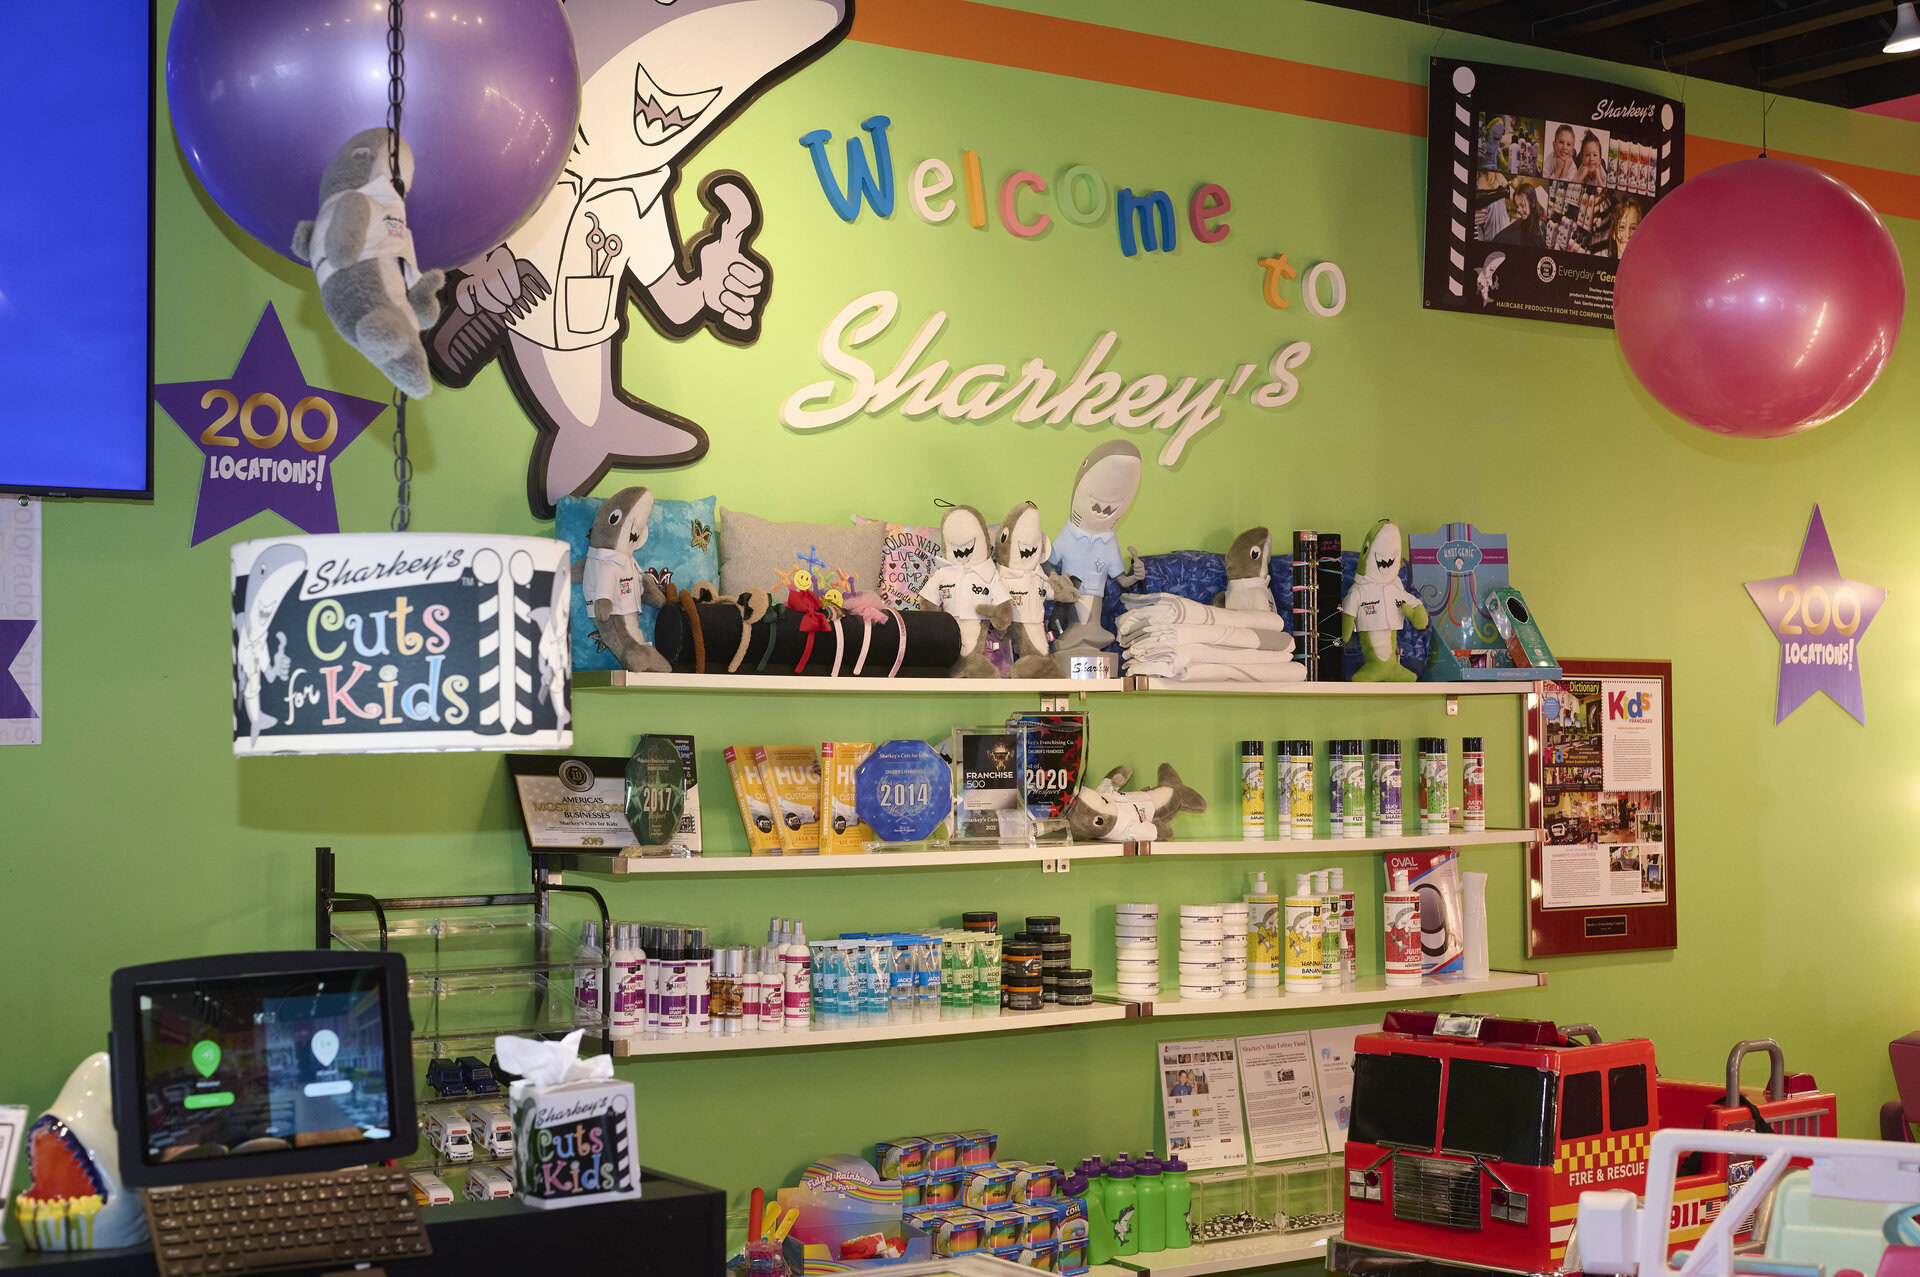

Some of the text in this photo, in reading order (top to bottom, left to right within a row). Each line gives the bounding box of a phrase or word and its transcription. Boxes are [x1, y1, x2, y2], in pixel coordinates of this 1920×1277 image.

[1592, 99, 1656, 123] Sharkey's
[799, 115, 1346, 317] Welcome to
[1558, 266, 1594, 282] Everyday
[1596, 270, 1616, 283] “Gen
[1496, 301, 1524, 310] HAIRCARE
[1524, 304, 1553, 313] PRODUCTS
[779, 290, 1311, 467] Sharkey's
[201, 389, 338, 452] 200
[210, 455, 326, 492] LOCATIONS!
[882, 532, 940, 557] COLOR WAR
[890, 552, 915, 561] LIVE
[14, 509, 40, 618] olorado
[308, 548, 464, 595] Sharkey's
[901, 562, 909, 571] 4
[1778, 584, 1861, 636] 200
[306, 596, 451, 661] Cuts
[1785, 638, 1854, 672] LOCATIONS!
[284, 655, 470, 726] for Kids
[1608, 690, 1650, 720] Kids
[1544, 747, 1568, 764] Kids
[774, 766, 821, 784] HUG
[966, 780, 986, 788] 500
[1026, 768, 1068, 790] 2020
[643, 788, 672, 812] 2017
[880, 784, 928, 806] 2014
[581, 837, 604, 845] 2019
[1392, 857, 1418, 867] OVAL
[536, 1097, 608, 1126] Sharkey's
[537, 1124, 604, 1162] Cuts
[543, 1153, 614, 1196] Kids
[807, 1172, 873, 1190] Fidget Rainbow
[1569, 1162, 1645, 1187] FIRE & RESCUE
[1066, 1206, 1081, 1217] COIL
[1670, 1202, 1699, 1230] 911
